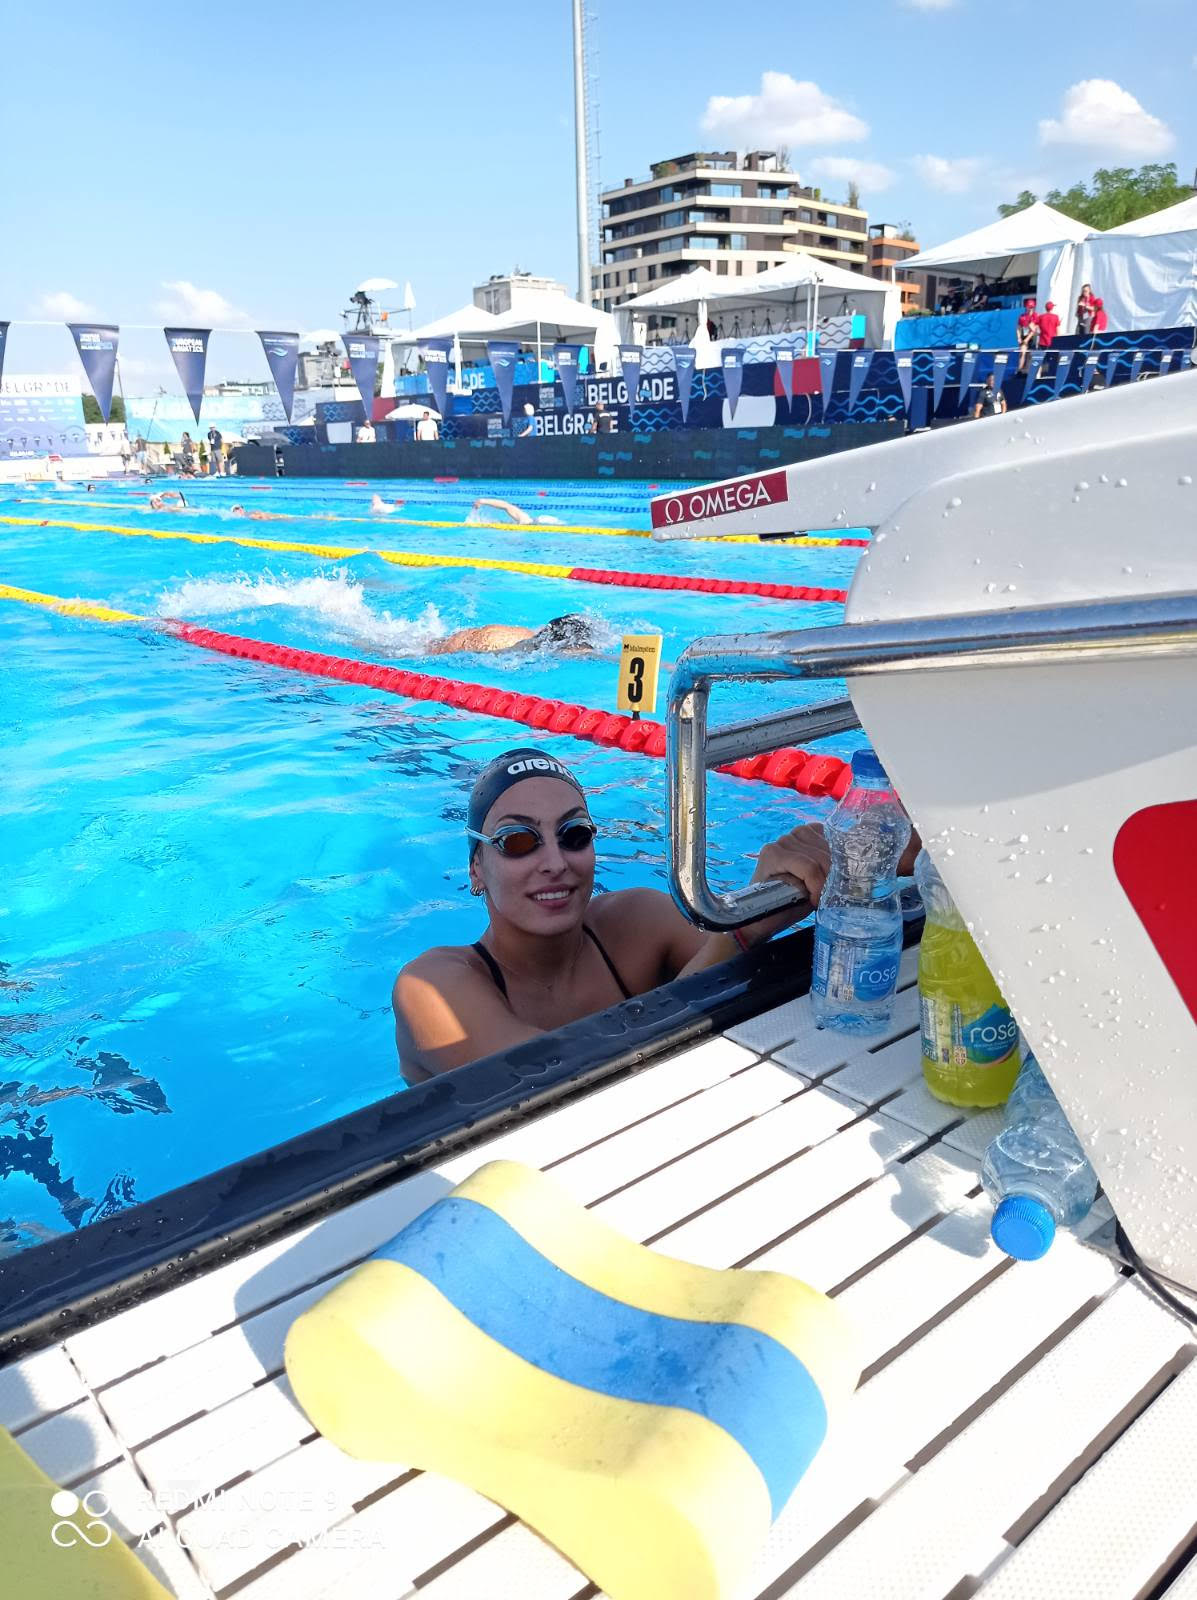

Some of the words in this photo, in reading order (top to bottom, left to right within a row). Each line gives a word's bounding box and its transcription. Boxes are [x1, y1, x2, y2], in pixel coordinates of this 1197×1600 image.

[588, 377, 674, 406] BELGADE
[535, 411, 618, 436] BELGRAE
[689, 480, 771, 518] OMEGA
[628, 656, 645, 703] 3
[859, 966, 896, 983] rosa
[970, 1021, 1016, 1043] rosa
